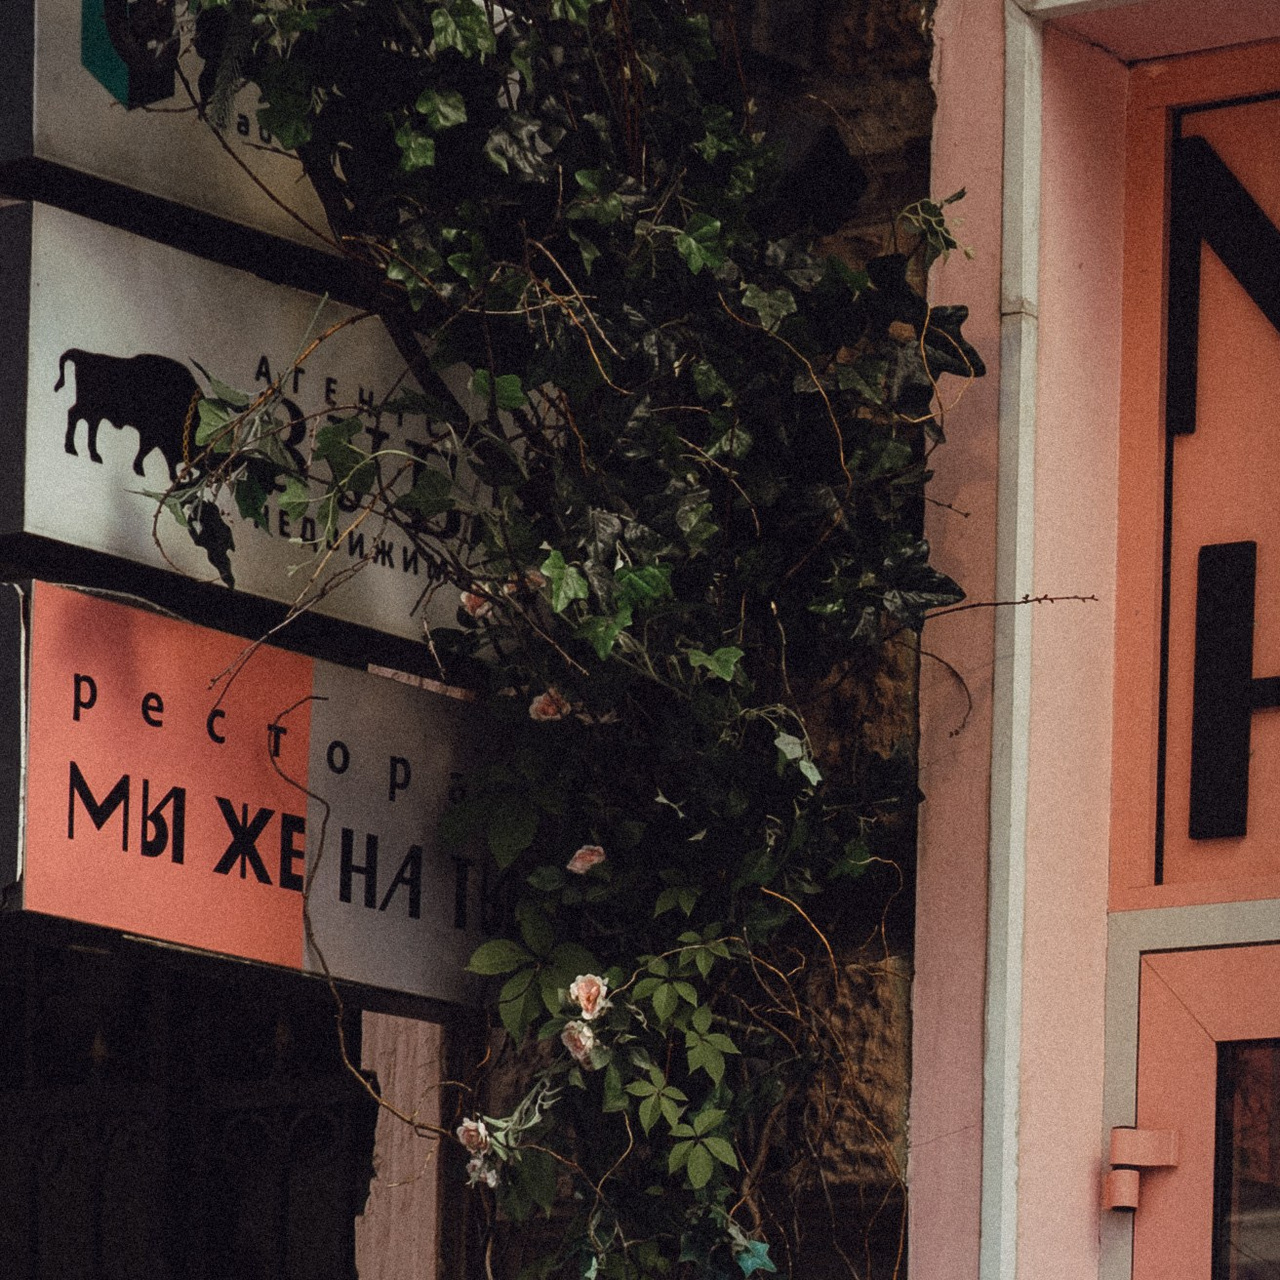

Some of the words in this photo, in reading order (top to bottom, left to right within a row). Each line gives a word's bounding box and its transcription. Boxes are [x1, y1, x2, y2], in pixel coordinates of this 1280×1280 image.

[68, 760, 186, 865] МЫ
[214, 796, 308, 893] ЖЕ
[338, 828, 424, 921] НА
